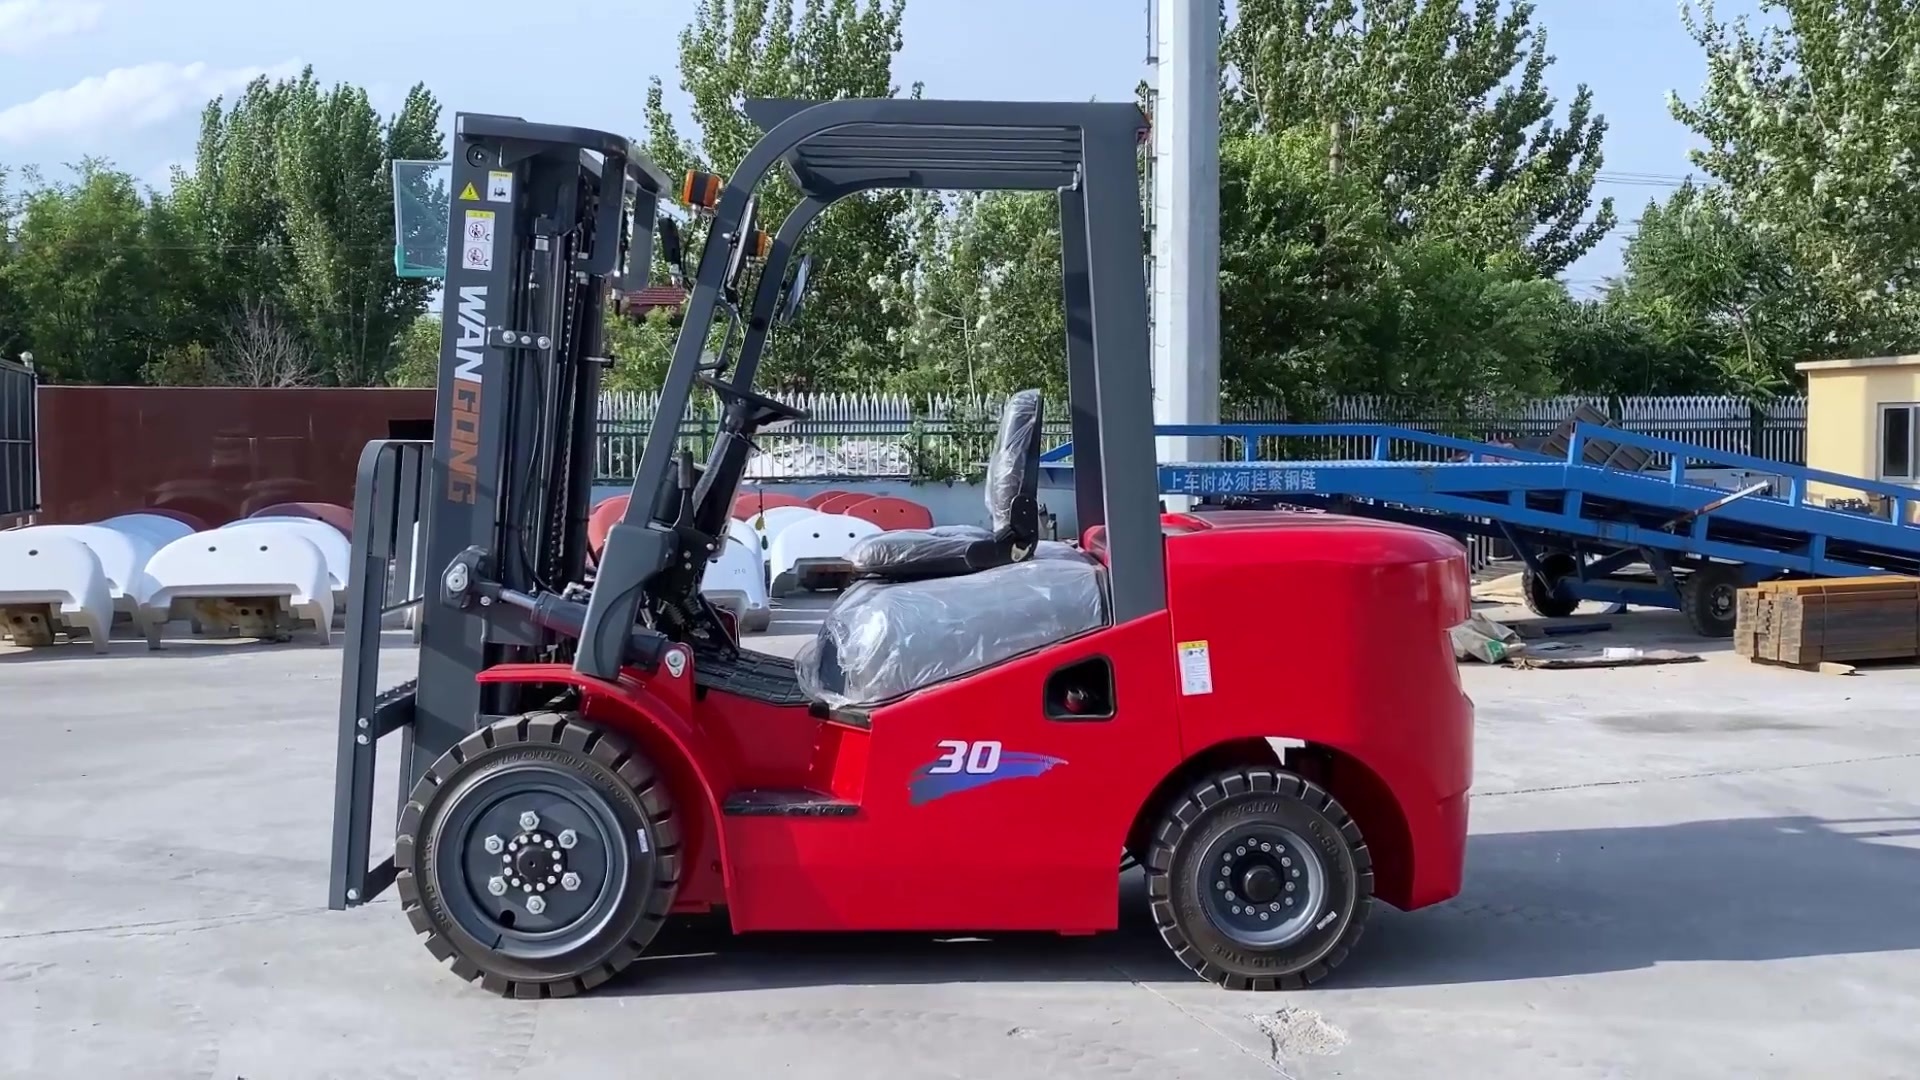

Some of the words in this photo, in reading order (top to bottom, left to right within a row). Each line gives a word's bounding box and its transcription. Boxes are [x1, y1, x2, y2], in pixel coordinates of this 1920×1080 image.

[448, 285, 488, 505] WANGONG
[1166, 469, 1316, 493] 上车时必须挂紧钢链
[929, 740, 1002, 774] 30
